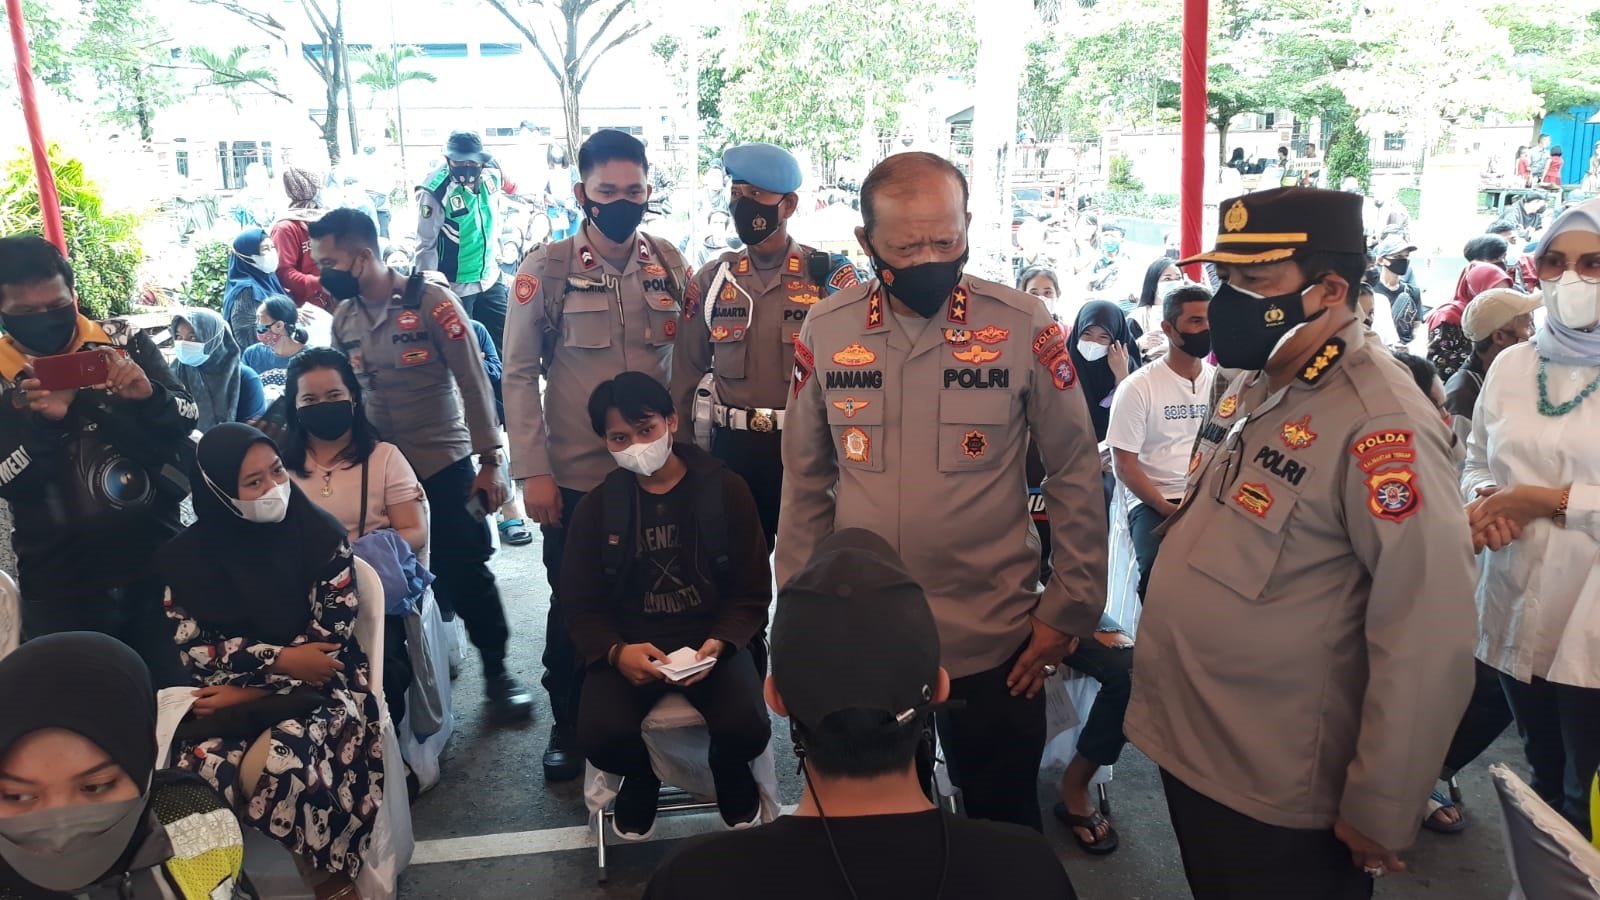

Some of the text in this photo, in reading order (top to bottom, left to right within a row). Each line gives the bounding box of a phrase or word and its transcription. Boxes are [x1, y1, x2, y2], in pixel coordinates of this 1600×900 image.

[826, 371, 882, 389] NANANG
[944, 368, 1009, 388] POLRI
[1357, 433, 1406, 454] POLDA
[1253, 446, 1307, 486] POLRI
